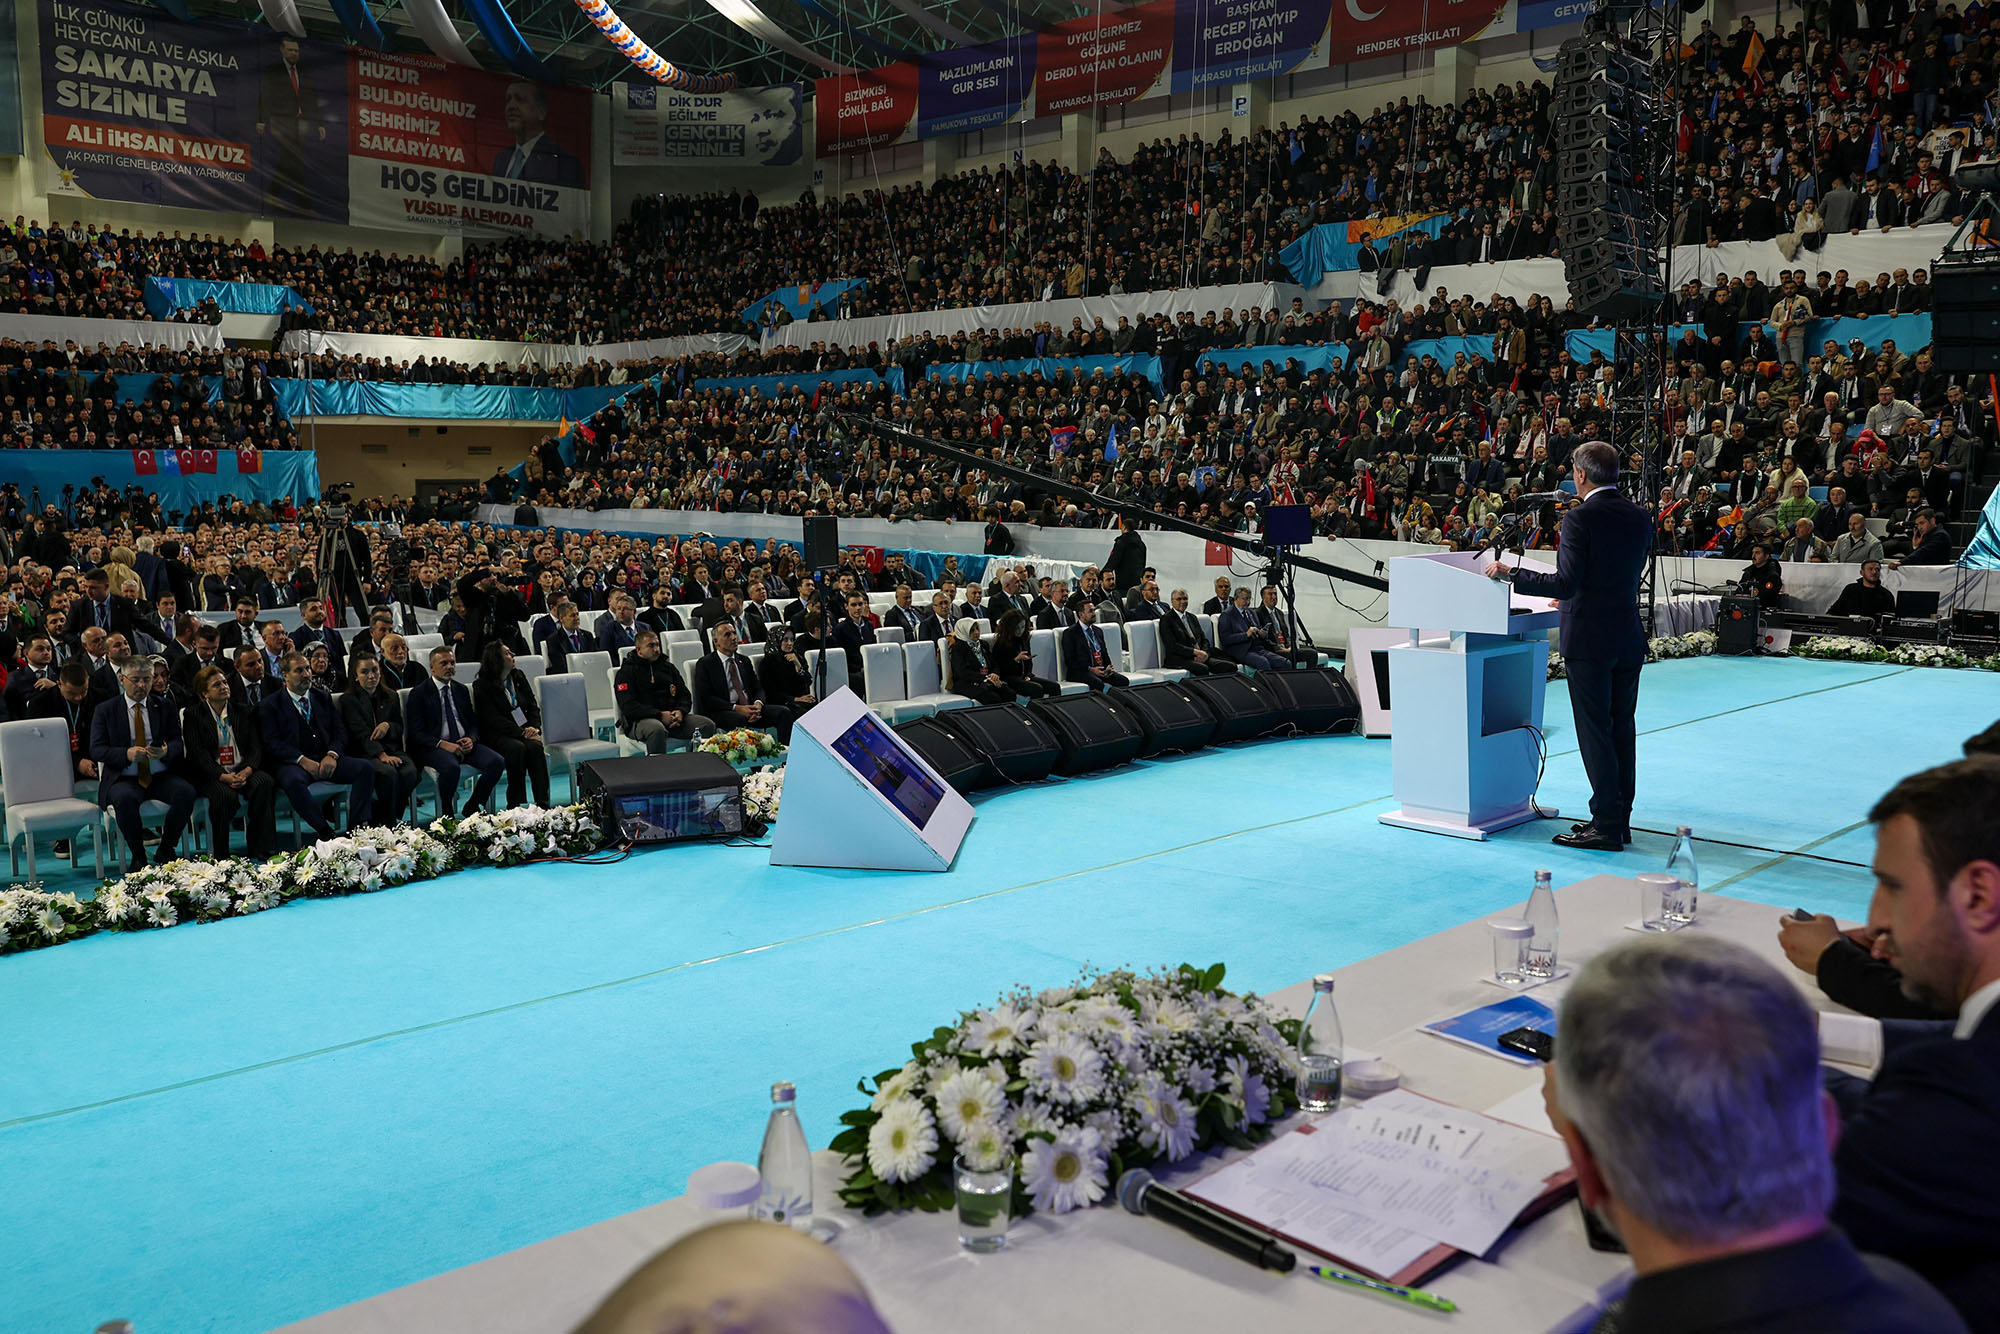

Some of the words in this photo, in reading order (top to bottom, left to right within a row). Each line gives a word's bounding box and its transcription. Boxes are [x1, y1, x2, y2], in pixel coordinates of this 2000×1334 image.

[53, 0, 80, 22] İLK
[84, 10, 145, 35] GÜNKÜ
[1226, 0, 1275, 17] BAŞKAN
[1067, 30, 1097, 45] UYKU
[1202, 21, 1246, 40] RECEP
[1249, 10, 1298, 30] TAYYİP
[54, 22, 158, 56] HEYECANLA
[162, 42, 184, 60] VE
[187, 47, 239, 70] AŞKLA
[1215, 31, 1283, 56] ERDOĞAN
[1356, 38, 1401, 55] HENDEK
[1403, 27, 1460, 46] TEŞKİLATI
[54, 44, 217, 97] SAKARYA
[358, 60, 420, 86] HUZUR
[939, 56, 1014, 81] MAZLUMLARIN
[1045, 65, 1078, 81] DERDİ
[1080, 59, 1116, 74] VATAN
[1118, 48, 1163, 67] OLANIN
[1194, 69, 1231, 84] KARASU
[976, 75, 999, 90] SESİ
[56, 80, 188, 124] SİZİNLE
[358, 84, 476, 119] BULDUĞUNUZ
[668, 95, 691, 107] DİK
[693, 97, 722, 107] DUR
[871, 96, 893, 112] BAĞI
[1049, 95, 1093, 110] KAYNARCA
[1236, 98, 1246, 110] P
[358, 108, 441, 136] ŞEHRİMİZ
[668, 109, 717, 121] EĞİLME
[931, 118, 968, 131] PAMUKOVA
[66, 124, 103, 145] ALİ
[107, 128, 174, 155] İHSAN
[177, 139, 246, 164] YAVUZ
[666, 125, 745, 142] GENÇLİK
[358, 132, 465, 163] SAKARYA'YA
[666, 142, 741, 156] SENİNLE
[1014, 150, 1022, 160] N
[65, 150, 82, 161] AK
[83, 152, 114, 166] PARTİ
[115, 156, 149, 170] GENEL
[151, 160, 192, 176] BAŞKAN
[814, 170, 823, 180] M
[381, 165, 437, 197] HOŞ
[443, 174, 560, 212] GELDİNİZ
[404, 198, 457, 217] YUSUF
[461, 206, 534, 229] ALEMDAR
